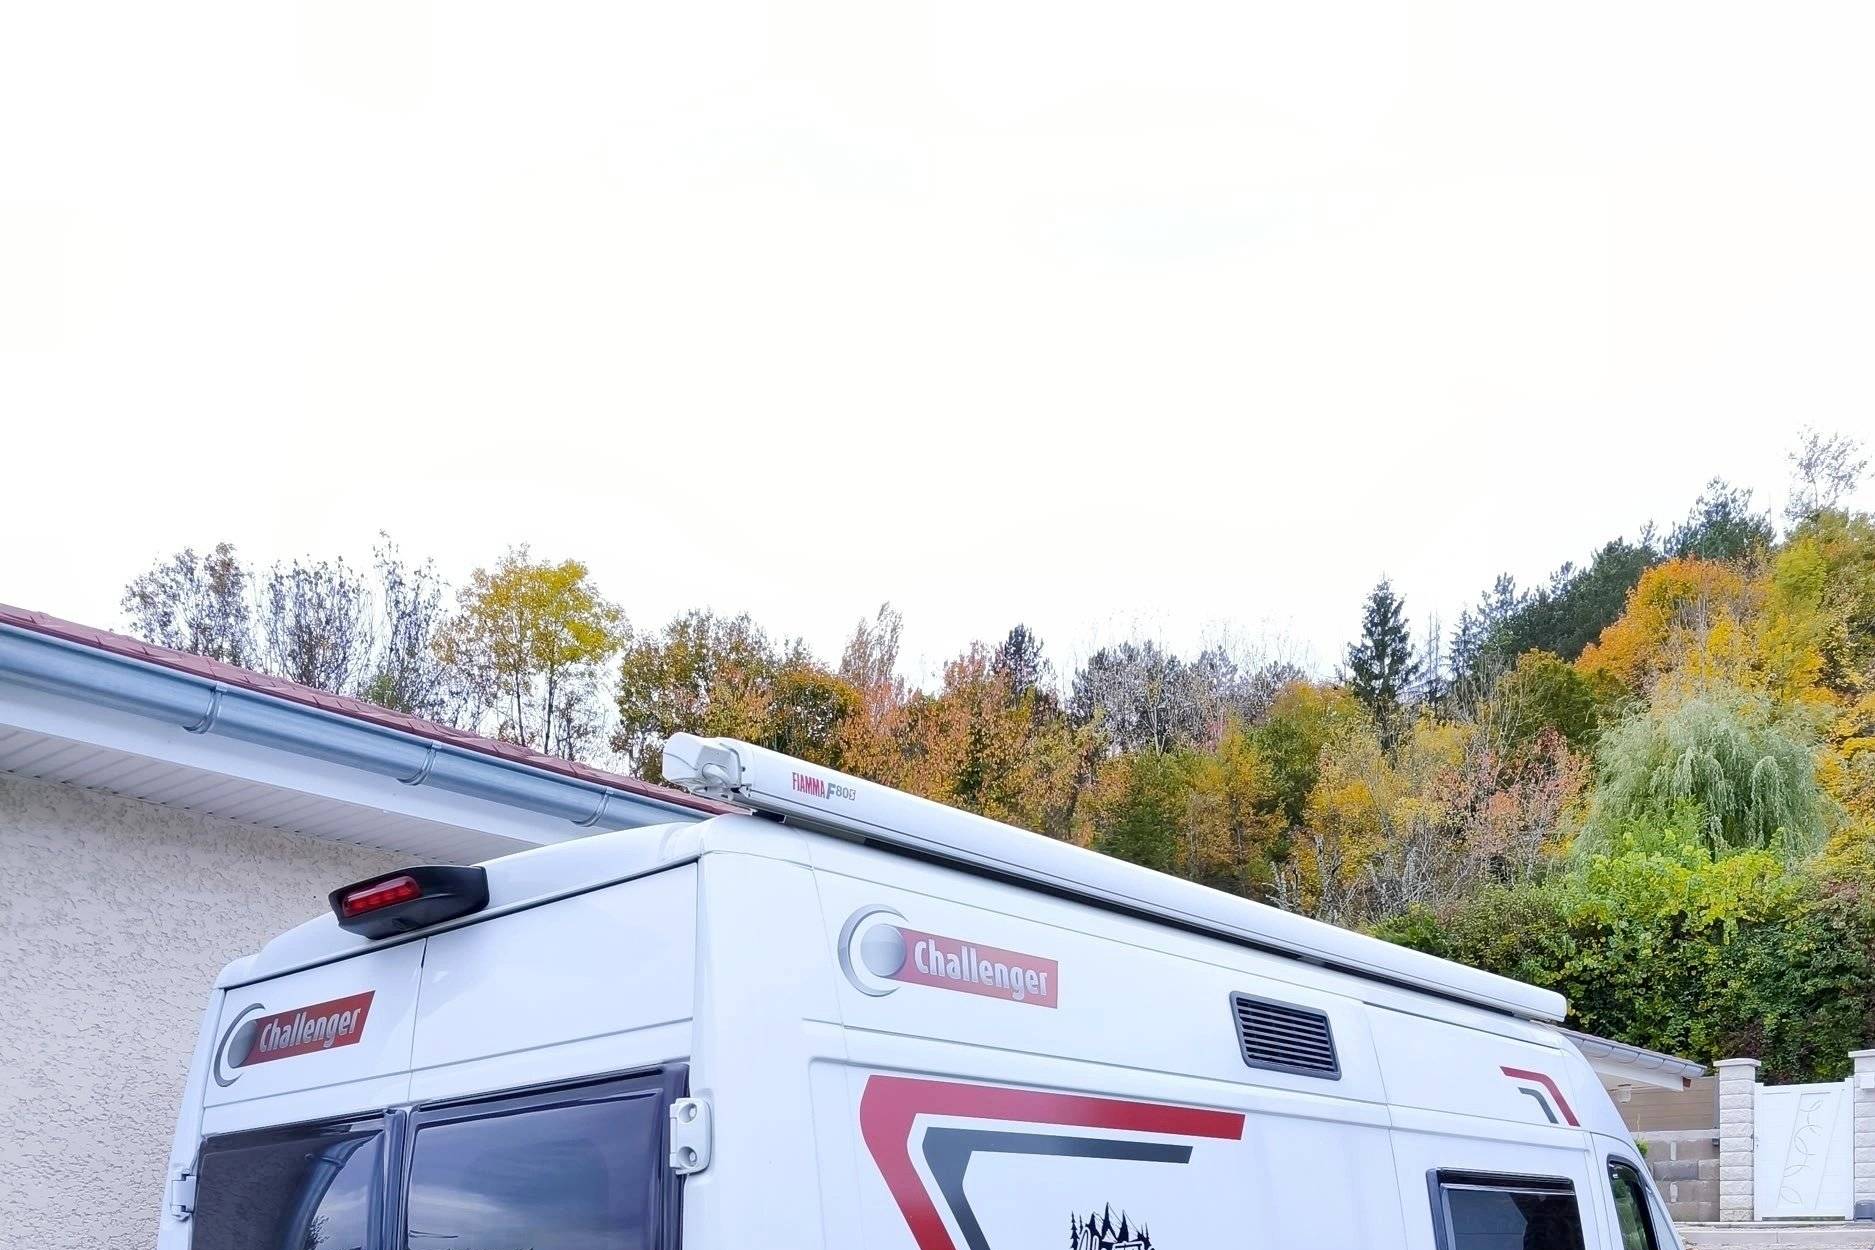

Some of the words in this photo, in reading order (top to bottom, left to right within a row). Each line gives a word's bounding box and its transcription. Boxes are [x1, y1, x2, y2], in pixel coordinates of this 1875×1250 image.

[792, 771, 826, 799] FIAMMA
[914, 940, 1048, 1001] Challenger
[260, 1008, 361, 1052] Challenger
